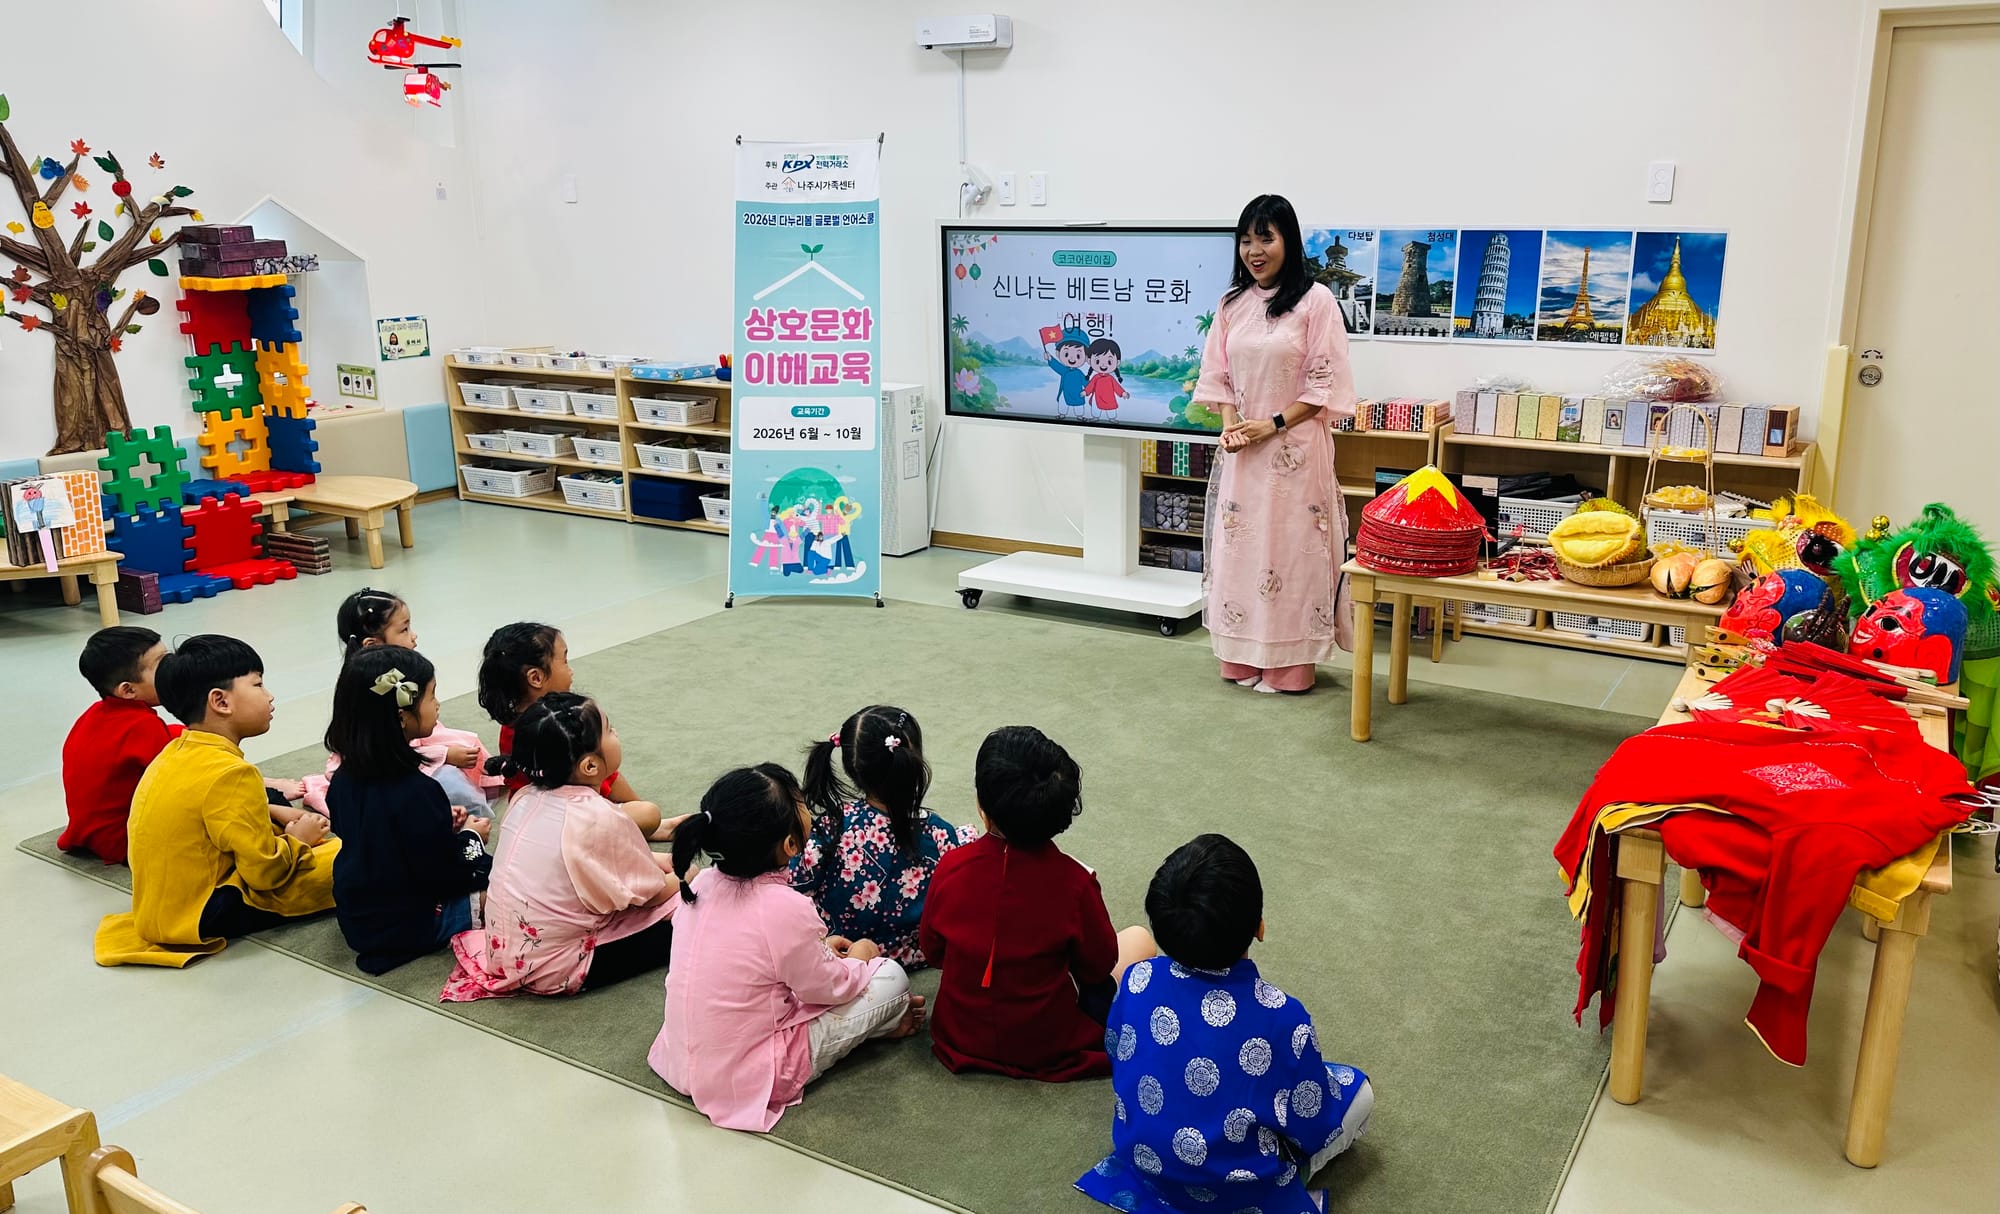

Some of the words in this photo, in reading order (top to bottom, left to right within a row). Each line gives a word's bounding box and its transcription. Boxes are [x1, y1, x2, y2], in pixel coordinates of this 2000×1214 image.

[765, 161, 778, 169] 후원
[783, 160, 813, 169] KPX
[765, 182, 778, 190] 주관
[797, 180, 855, 191] 나주시가족센터
[744, 213, 777, 226] 2026년
[779, 215, 812, 227] 다누리봄
[815, 214, 840, 227] 글로벌
[843, 212, 874, 226] 언어스쿨
[1348, 231, 1374, 242] 다보탑
[1427, 231, 1454, 243] 첨성대
[1058, 254, 1111, 265] 코코어린이집
[992, 274, 1057, 300] 신나는
[1067, 276, 1135, 302] 베트남
[1144, 278, 1192, 305] 문화
[745, 307, 873, 342] 상호문화
[1063, 312, 1113, 338] 여행!
[1589, 331, 1619, 344] 에펠탑
[745, 352, 871, 386] 이해교육
[797, 407, 825, 416] 교육기간
[753, 427, 795, 441] 2026년
[799, 426, 819, 441] 6월
[836, 426, 862, 441] 10월
